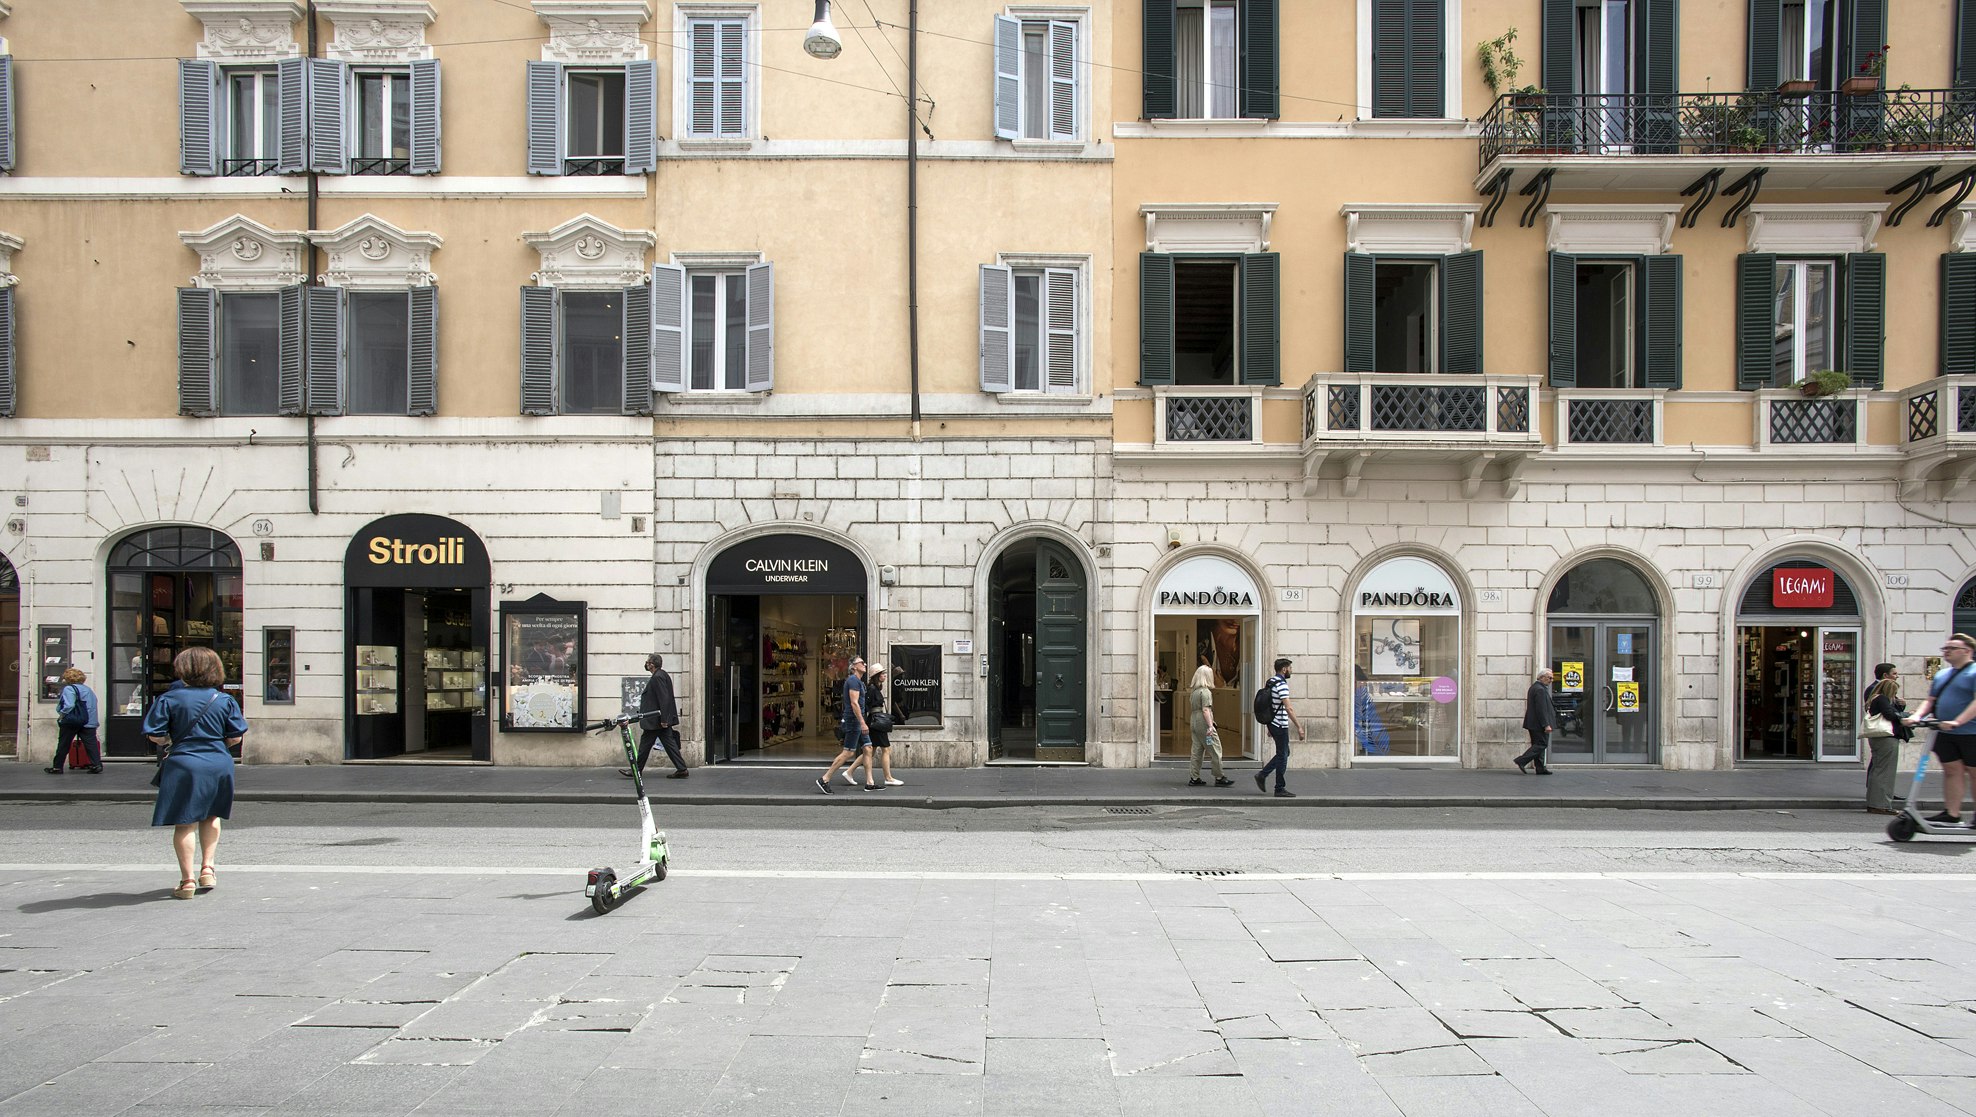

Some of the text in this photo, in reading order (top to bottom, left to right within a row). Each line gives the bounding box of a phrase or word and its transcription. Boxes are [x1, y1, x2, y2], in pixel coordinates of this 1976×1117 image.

[11, 523, 24, 532] 93
[257, 523, 269, 532] 94
[368, 536, 464, 564] Stroili
[1099, 547, 1111, 557] 97
[745, 559, 828, 572] CALVIN KLEIN
[1697, 577, 1712, 585] 99
[501, 583, 513, 594] 95
[1160, 591, 1253, 605] PANDORA
[1285, 590, 1300, 600] 98
[1362, 592, 1454, 606] PANDORA
[1483, 592, 1500, 601] 98A
[894, 679, 919, 687] CALVIN
